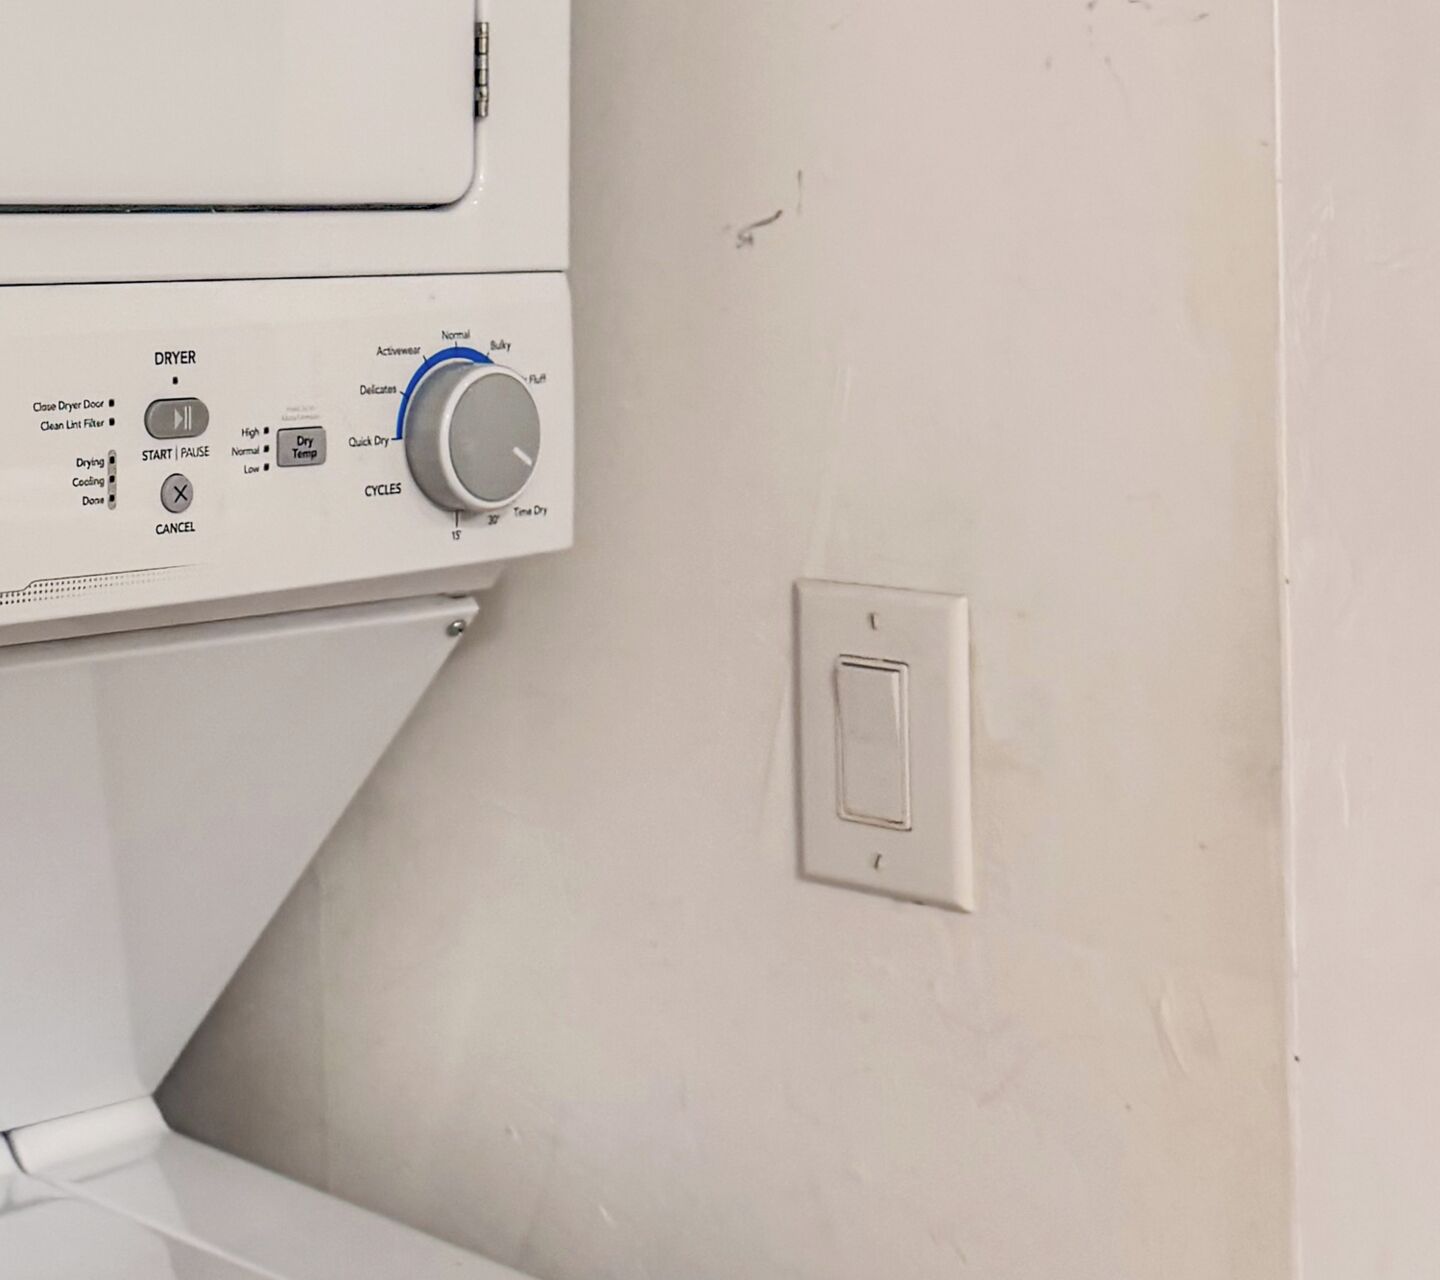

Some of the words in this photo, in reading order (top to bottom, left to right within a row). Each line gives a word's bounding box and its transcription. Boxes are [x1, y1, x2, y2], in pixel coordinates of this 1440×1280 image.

[377, 346, 420, 356] Activewear
[155, 350, 196, 365] DRYER
[360, 385, 396, 395] Delicates
[58, 401, 81, 412] Dryer
[84, 400, 104, 409] Door
[41, 421, 64, 431] Clean
[66, 420, 81, 429] Lint
[84, 418, 104, 427] Filter
[242, 428, 259, 439] High
[297, 435, 314, 448] Dry
[349, 436, 372, 447] Quick
[374, 435, 389, 448] Dry
[142, 449, 172, 461] START
[181, 446, 209, 458] PAUSE
[232, 446, 259, 456] Normal
[292, 448, 317, 461] Temp
[76, 458, 104, 469] Drying
[244, 465, 259, 474] Low
[72, 476, 104, 487] Cooling
[365, 483, 401, 496] CYCLES
[83, 496, 104, 505] Done
[156, 522, 195, 534] CANCEL
